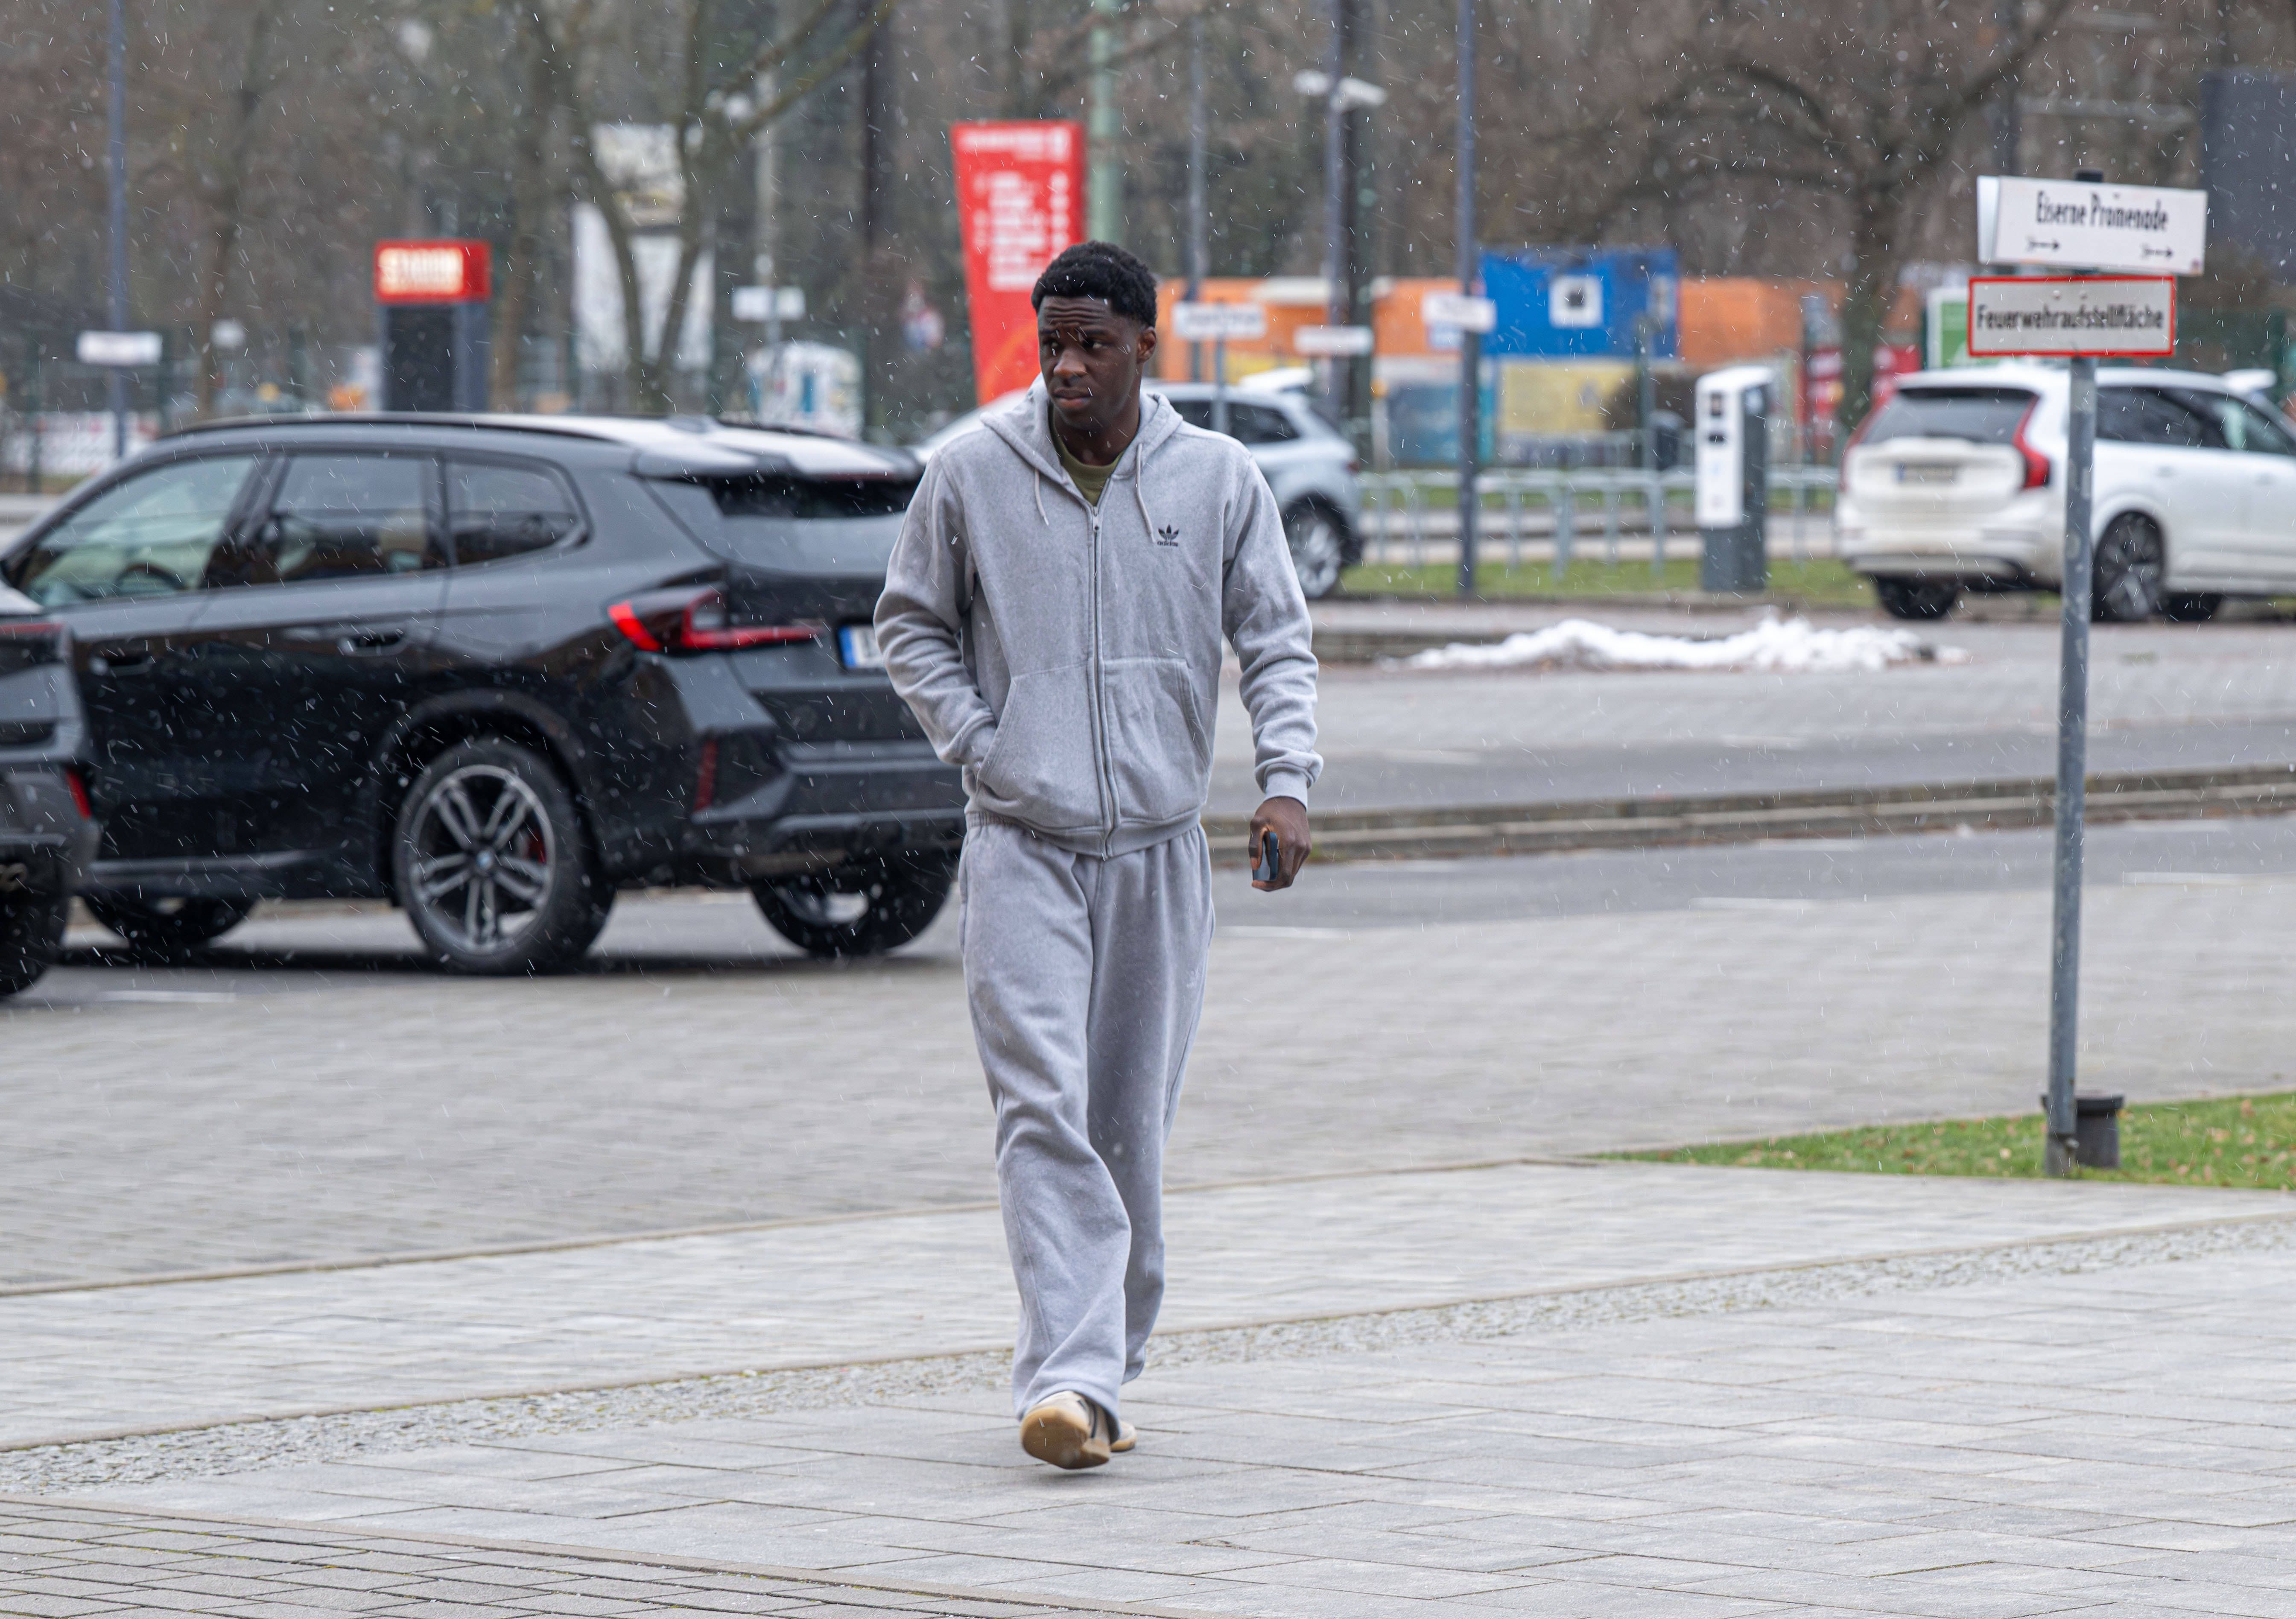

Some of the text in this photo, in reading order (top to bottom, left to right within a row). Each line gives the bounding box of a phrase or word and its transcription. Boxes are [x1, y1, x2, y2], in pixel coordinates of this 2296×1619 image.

[2036, 190, 2168, 231] Eiserne Promenade
[1976, 303, 2163, 330] Feuerwehraufstellfläche
